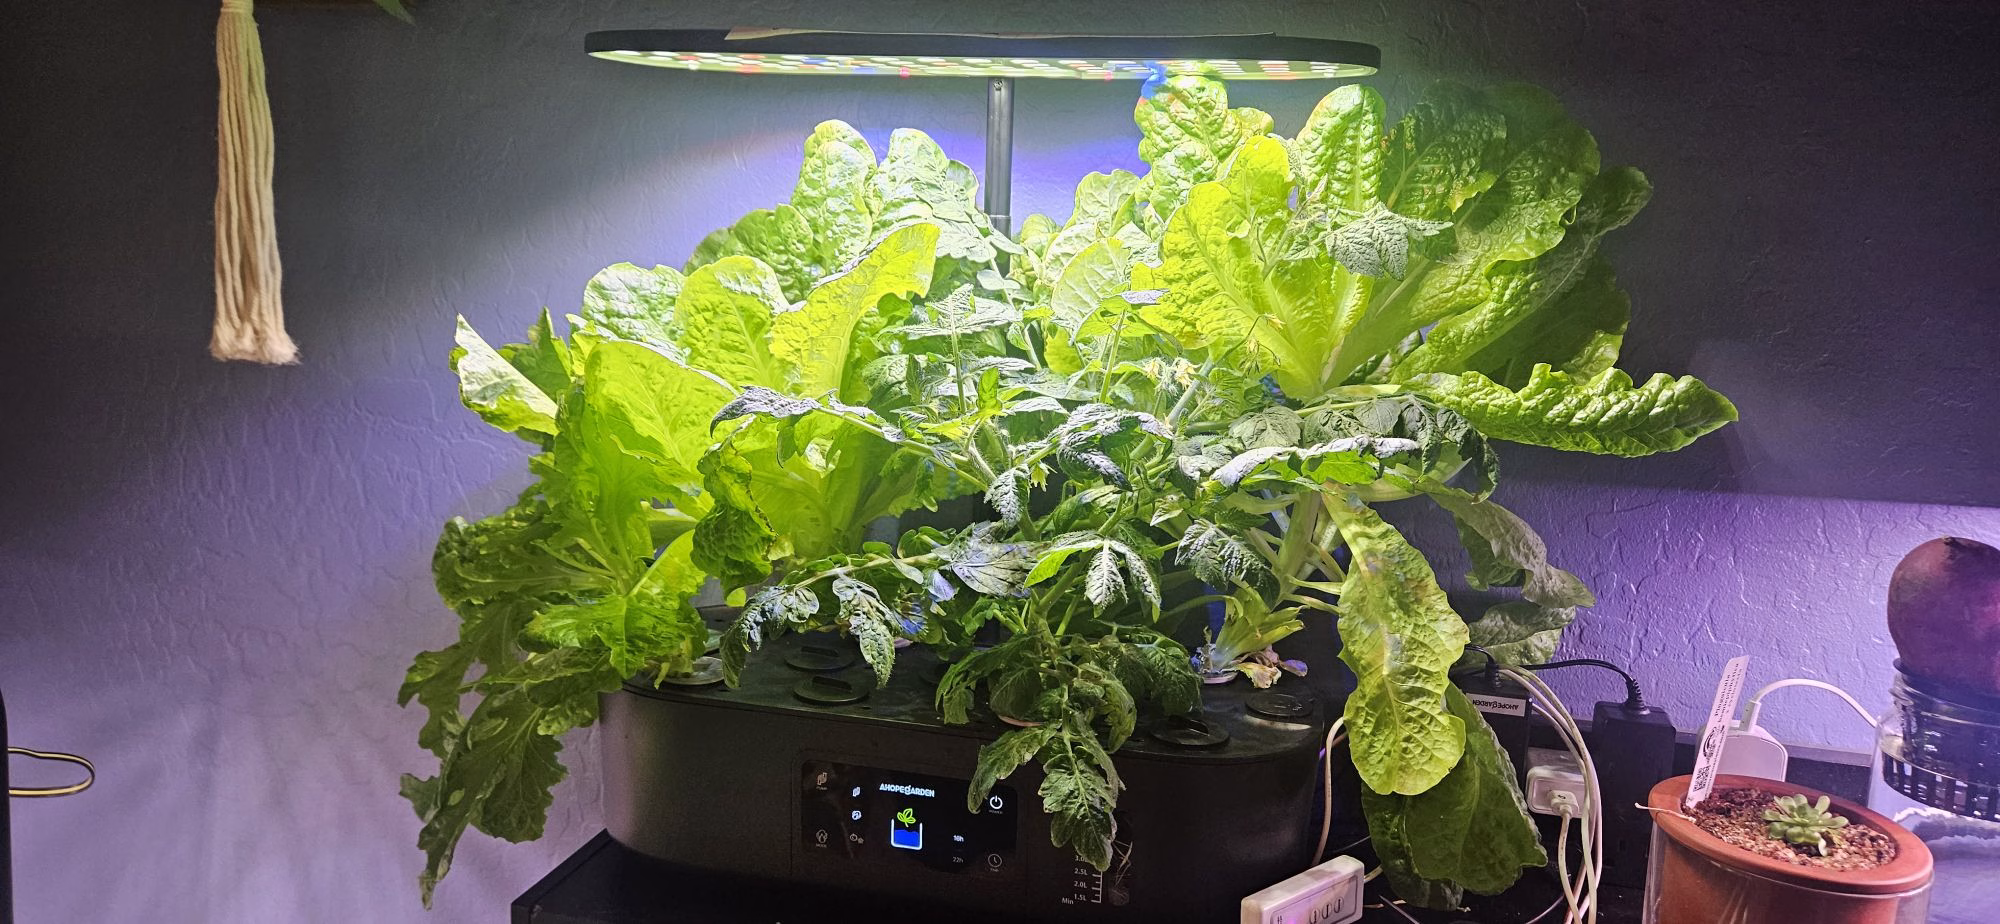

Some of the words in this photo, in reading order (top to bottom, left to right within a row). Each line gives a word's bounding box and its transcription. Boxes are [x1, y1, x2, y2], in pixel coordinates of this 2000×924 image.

[1074, 867, 1088, 876] 2.5L
[1061, 897, 1074, 905] Min
[1074, 893, 1087, 901] 1.5L
